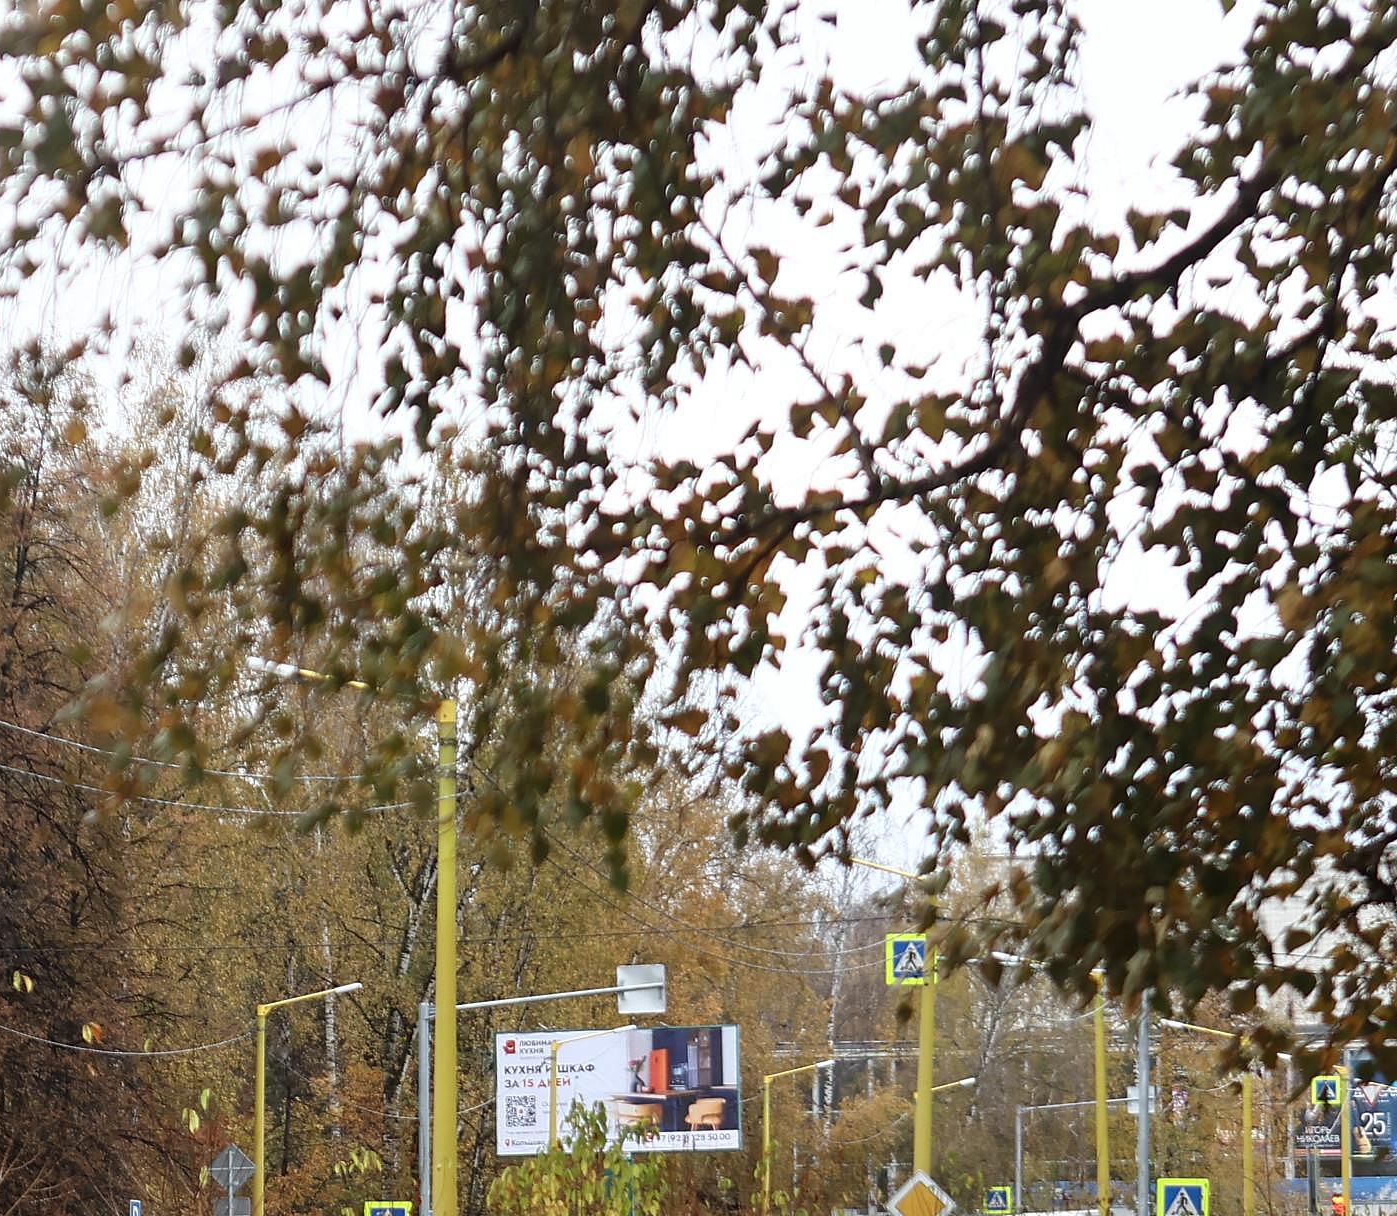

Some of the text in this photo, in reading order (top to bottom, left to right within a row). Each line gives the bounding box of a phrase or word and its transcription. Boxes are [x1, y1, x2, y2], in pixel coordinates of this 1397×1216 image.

[519, 1047, 544, 1055] КУХНЯ
[504, 1064, 542, 1075] КУХНЯ
[557, 1063, 595, 1073] ШКАФ
[504, 1079, 519, 1089] ЗА
[523, 1078, 534, 1088] 15
[1360, 1112, 1386, 1135] 25
[1304, 1126, 1331, 1134] ИГОРЬ
[1296, 1134, 1341, 1143] НИКОЛАЕВ
